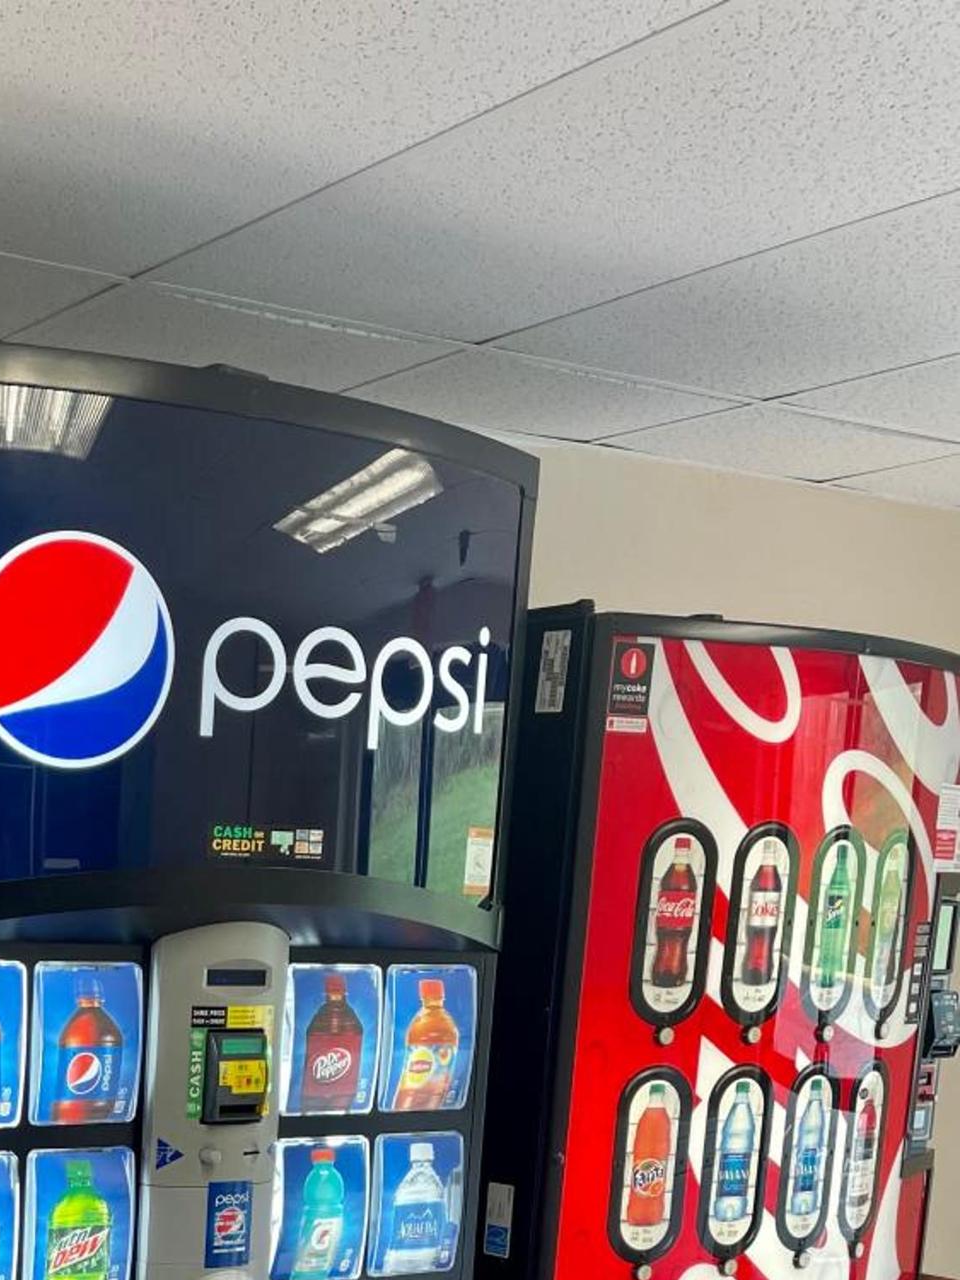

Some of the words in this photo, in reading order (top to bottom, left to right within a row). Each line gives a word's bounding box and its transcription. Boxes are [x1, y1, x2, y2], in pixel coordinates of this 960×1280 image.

[199, 616, 489, 750] pepsi
[213, 825, 252, 839] CASH
[212, 838, 265, 852] CREDIT
[100, 1053, 112, 1091] pepsi
[190, 1051, 203, 1098] CASH
[633, 1166, 666, 1187] Fanta
[215, 1191, 250, 1208] pepsi
